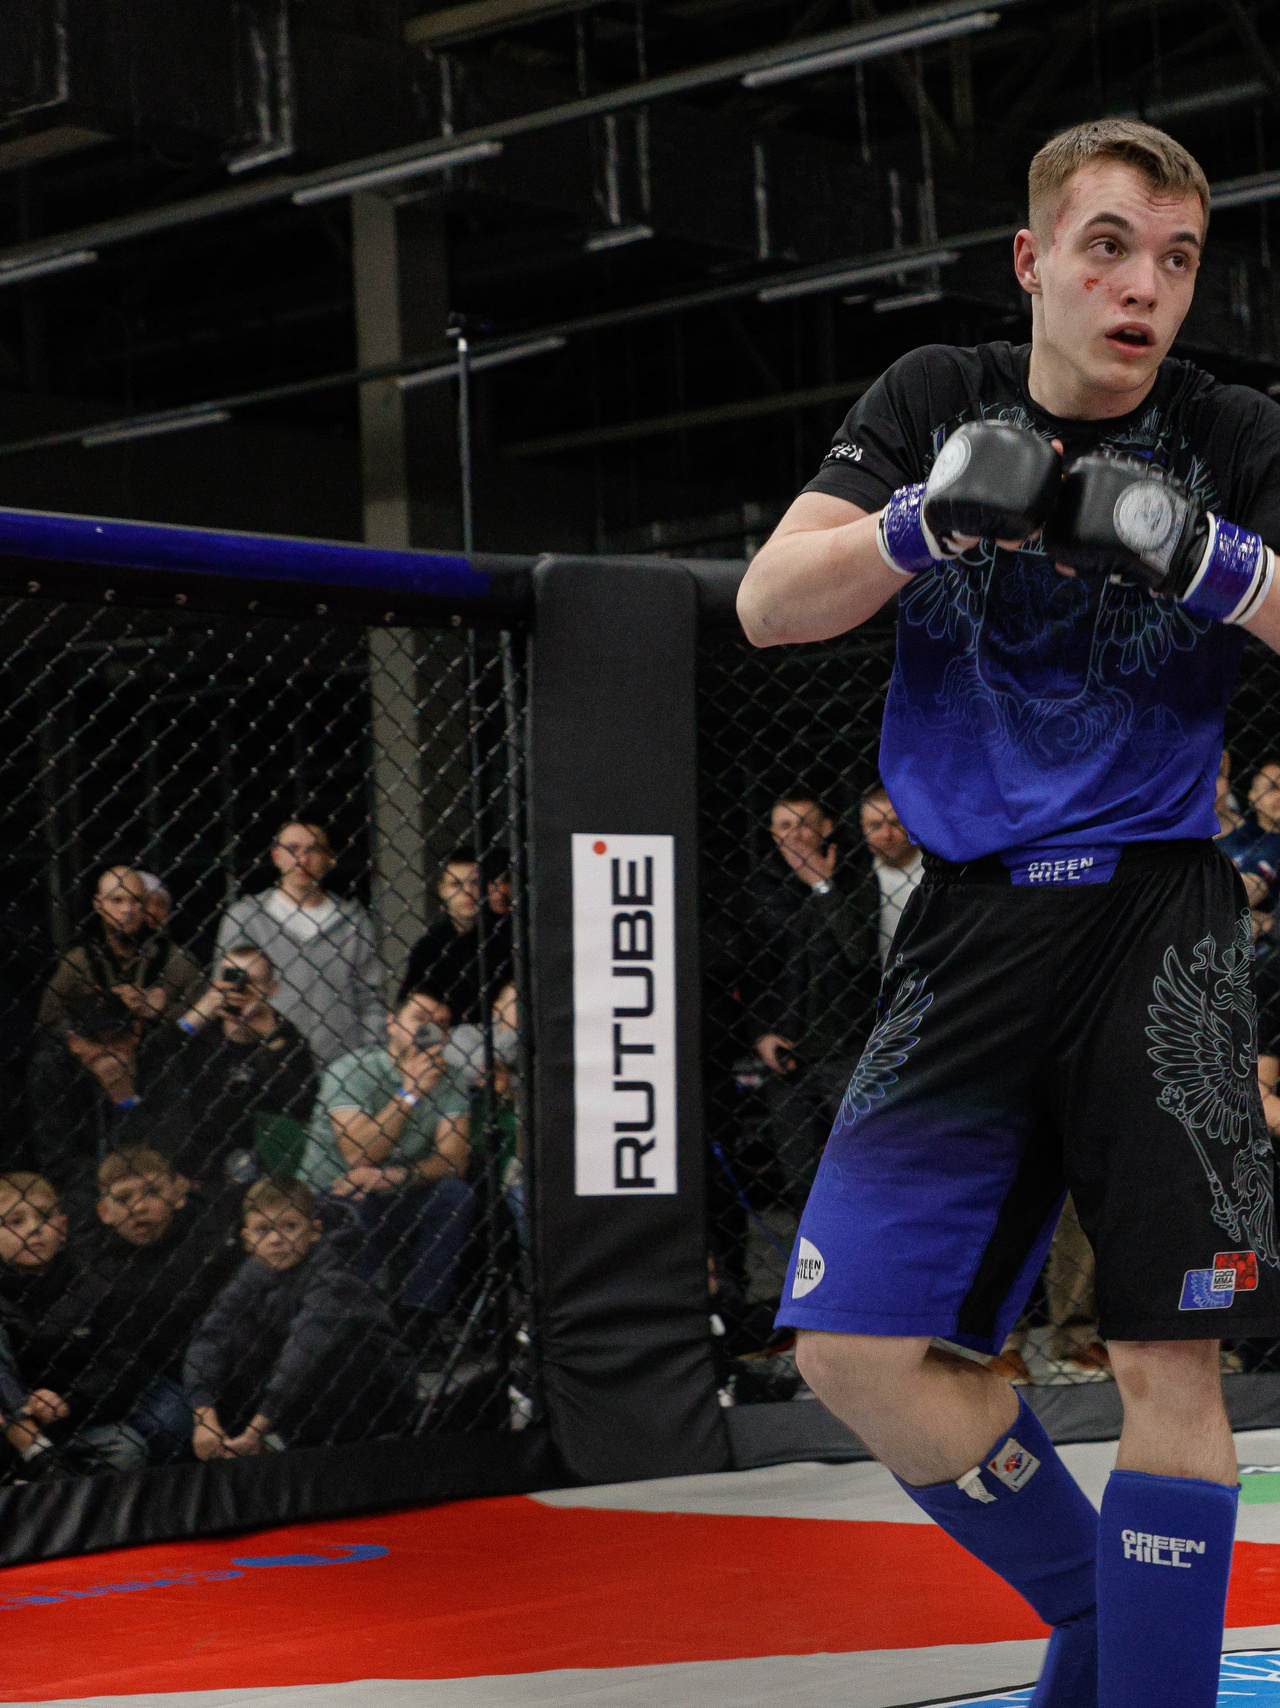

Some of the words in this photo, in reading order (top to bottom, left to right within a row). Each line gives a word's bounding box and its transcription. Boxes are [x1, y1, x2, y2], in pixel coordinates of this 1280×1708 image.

[1029, 870, 1081, 882] HILL
[611, 856, 656, 1189] RUTUBE
[1121, 1529, 1206, 1555] GREEN
[1123, 1542, 1192, 1568] HILL
